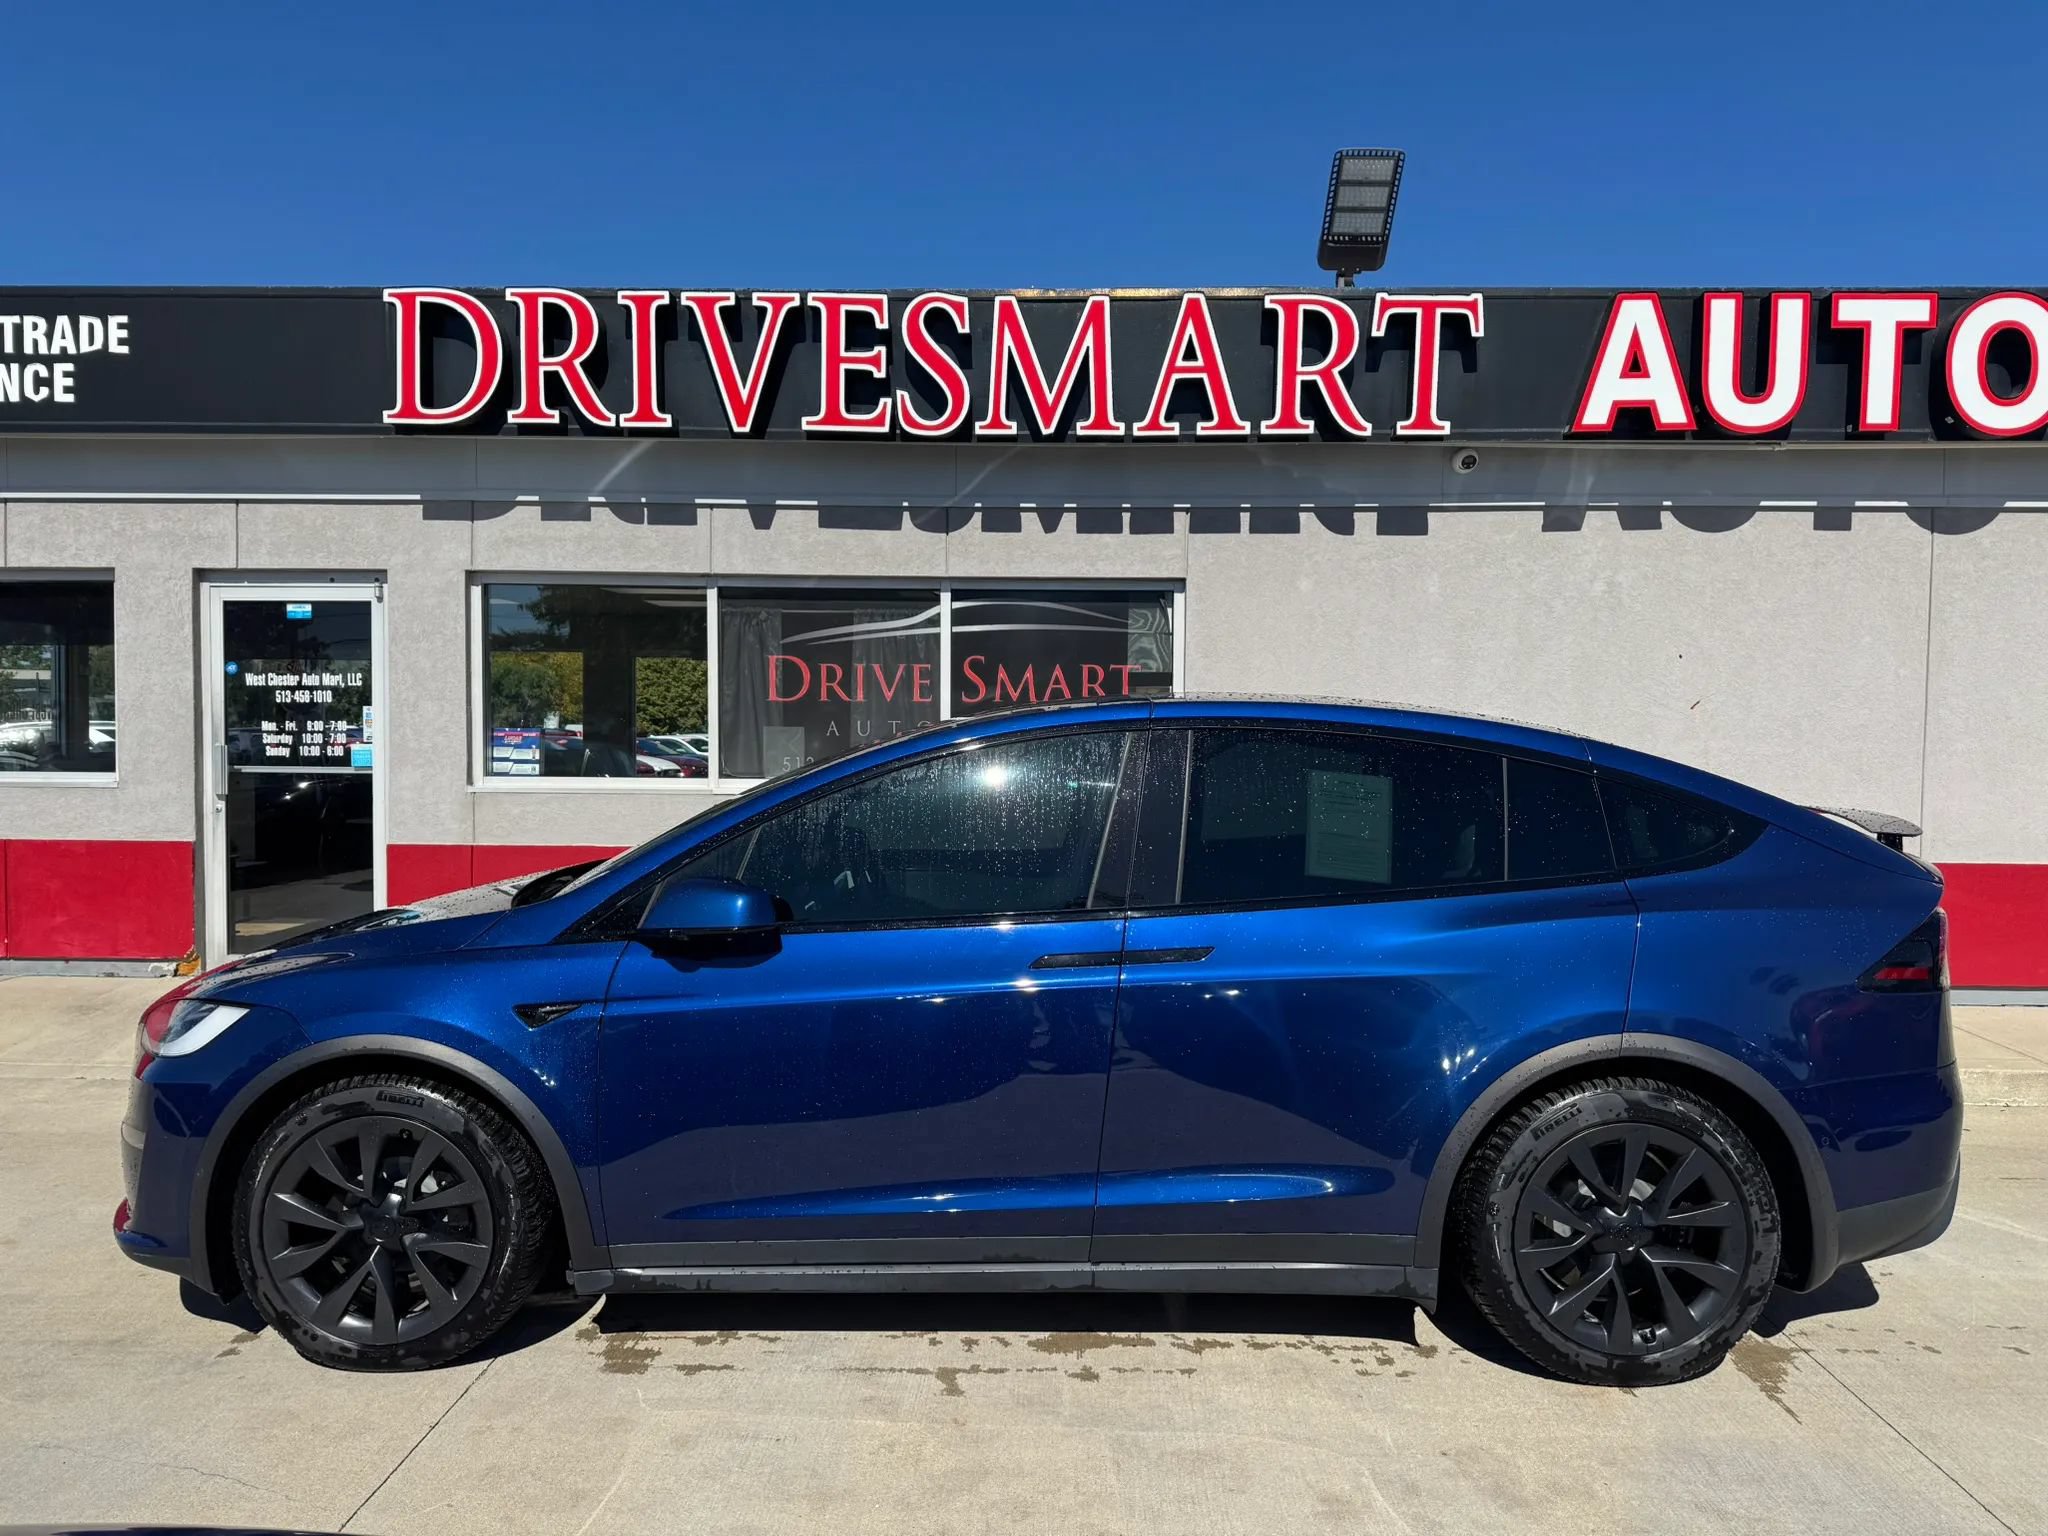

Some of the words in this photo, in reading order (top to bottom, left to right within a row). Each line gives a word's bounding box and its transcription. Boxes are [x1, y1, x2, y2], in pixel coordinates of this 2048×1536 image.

[0, 314, 130, 355] TRADE
[383, 288, 1485, 437] DRIVESMART
[1571, 291, 2048, 436] AUTO
[245, 672, 266, 686] West
[267, 672, 300, 686] Chester
[301, 672, 320, 686] Auto
[322, 672, 345, 688] Mart,
[347, 672, 363, 687] LLC
[767, 654, 933, 703] DRIVE
[960, 654, 1143, 704] SMART
[306, 720, 324, 731] 9:00
[826, 719, 931, 737] AUT
[262, 732, 293, 745] Saturday
[302, 733, 323, 744] 10:00
[329, 733, 347, 744] 7:00
[265, 745, 291, 758] Sunday
